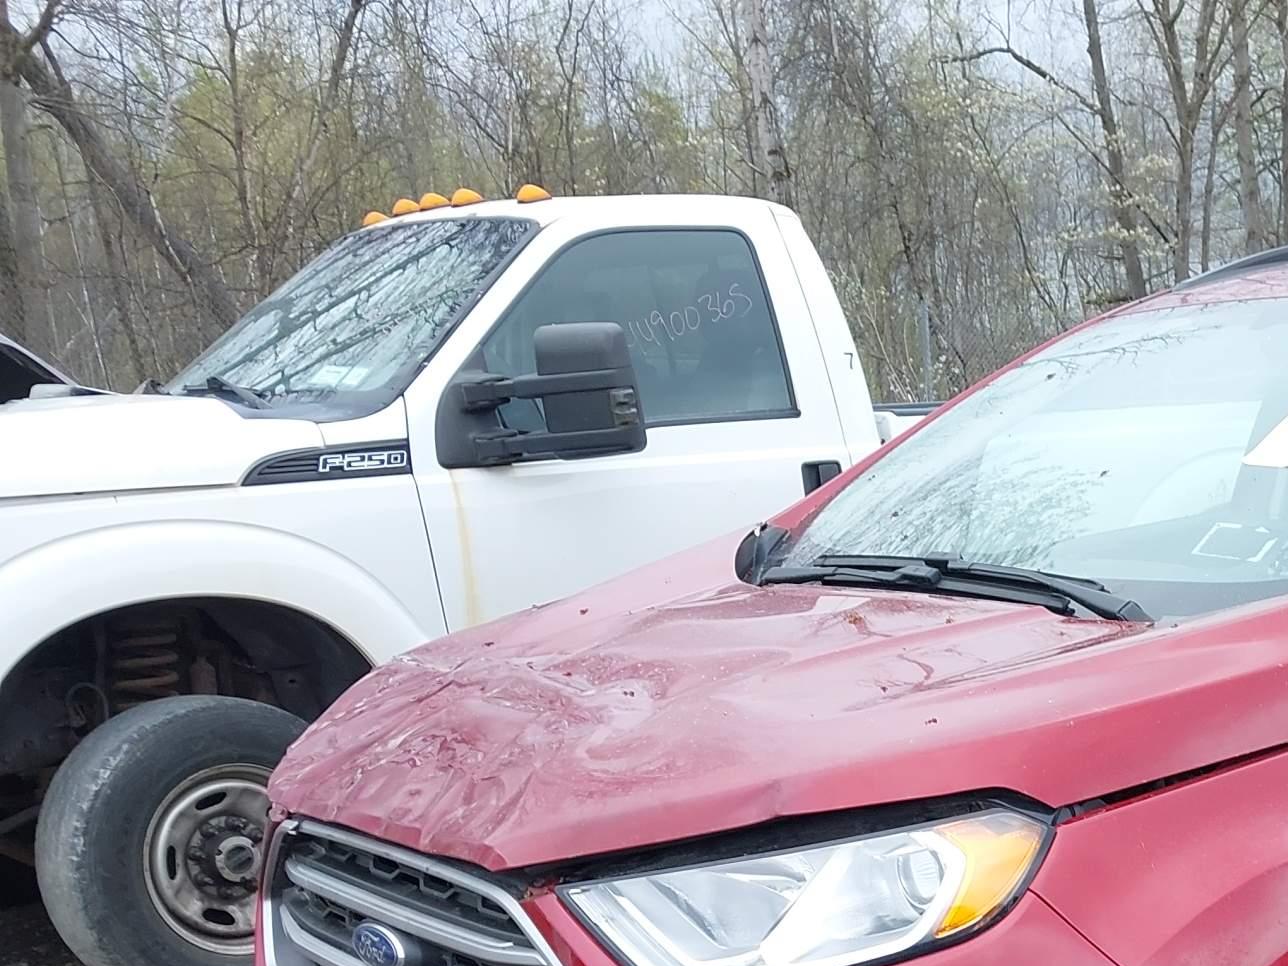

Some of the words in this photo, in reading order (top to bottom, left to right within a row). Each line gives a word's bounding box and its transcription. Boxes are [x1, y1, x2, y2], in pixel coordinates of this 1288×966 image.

[842, 351, 854, 370] 7
[317, 449, 407, 473] F-250
[357, 930, 386, 964] Ford
